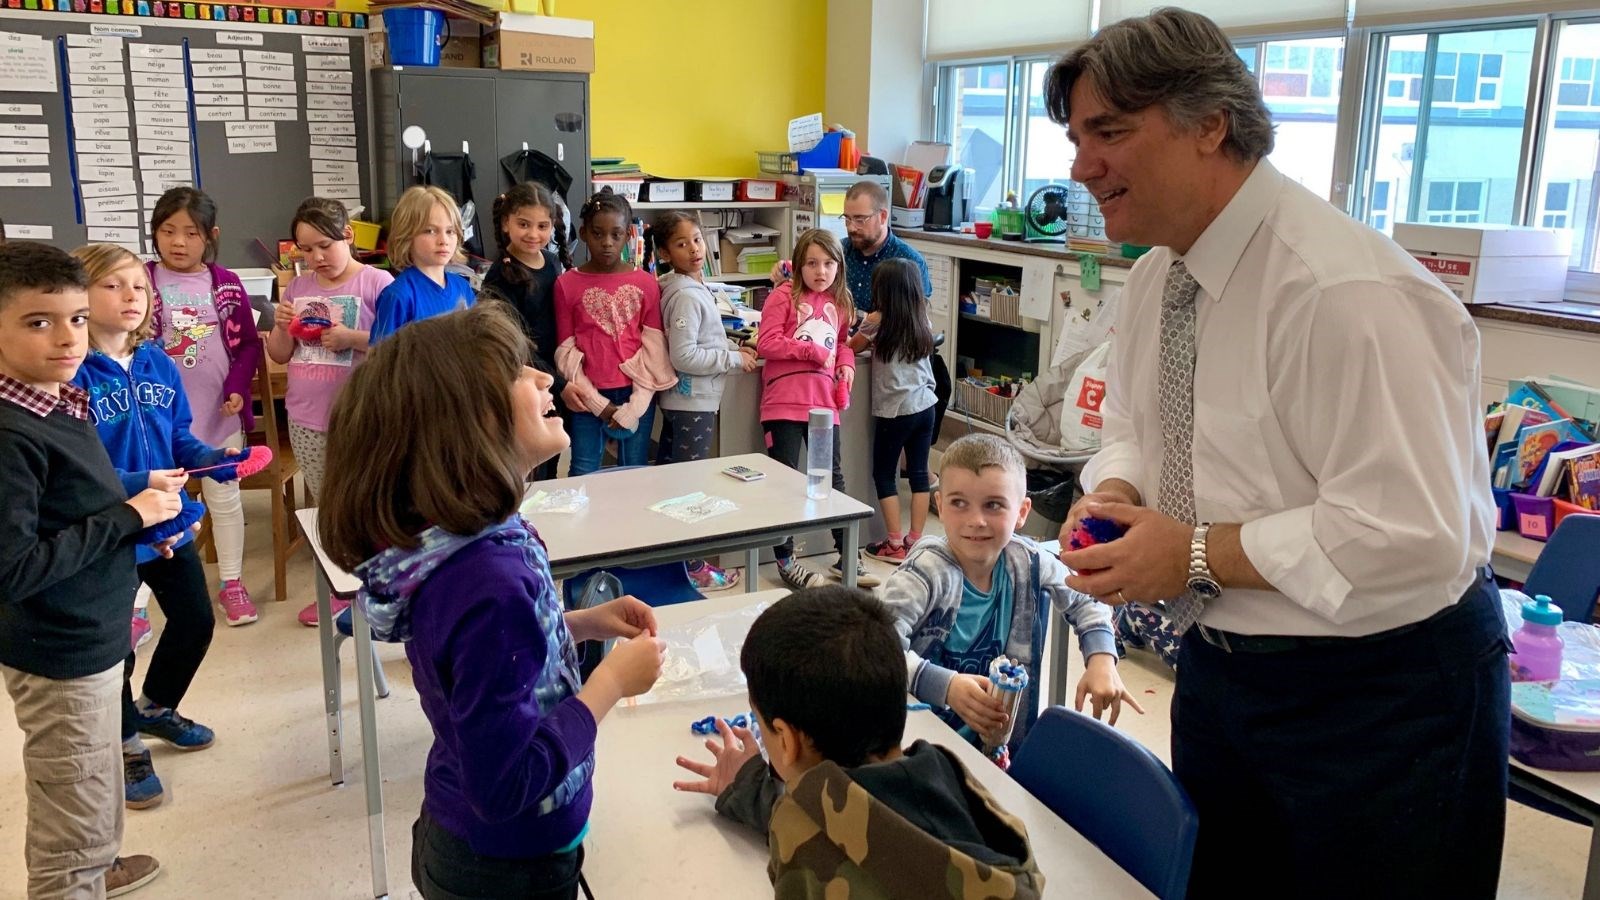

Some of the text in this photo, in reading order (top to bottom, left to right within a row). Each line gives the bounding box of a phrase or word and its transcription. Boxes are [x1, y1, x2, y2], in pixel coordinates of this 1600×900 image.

[89, 51, 102, 59] jour
[535, 55, 577, 65] ROLLAND
[208, 65, 226, 73] grand
[248, 123, 269, 131] grosse
[97, 199, 125, 207] premier
[1085, 380, 1104, 390] Super
[1086, 390, 1097, 407] C
[1527, 520, 1539, 529] 10
